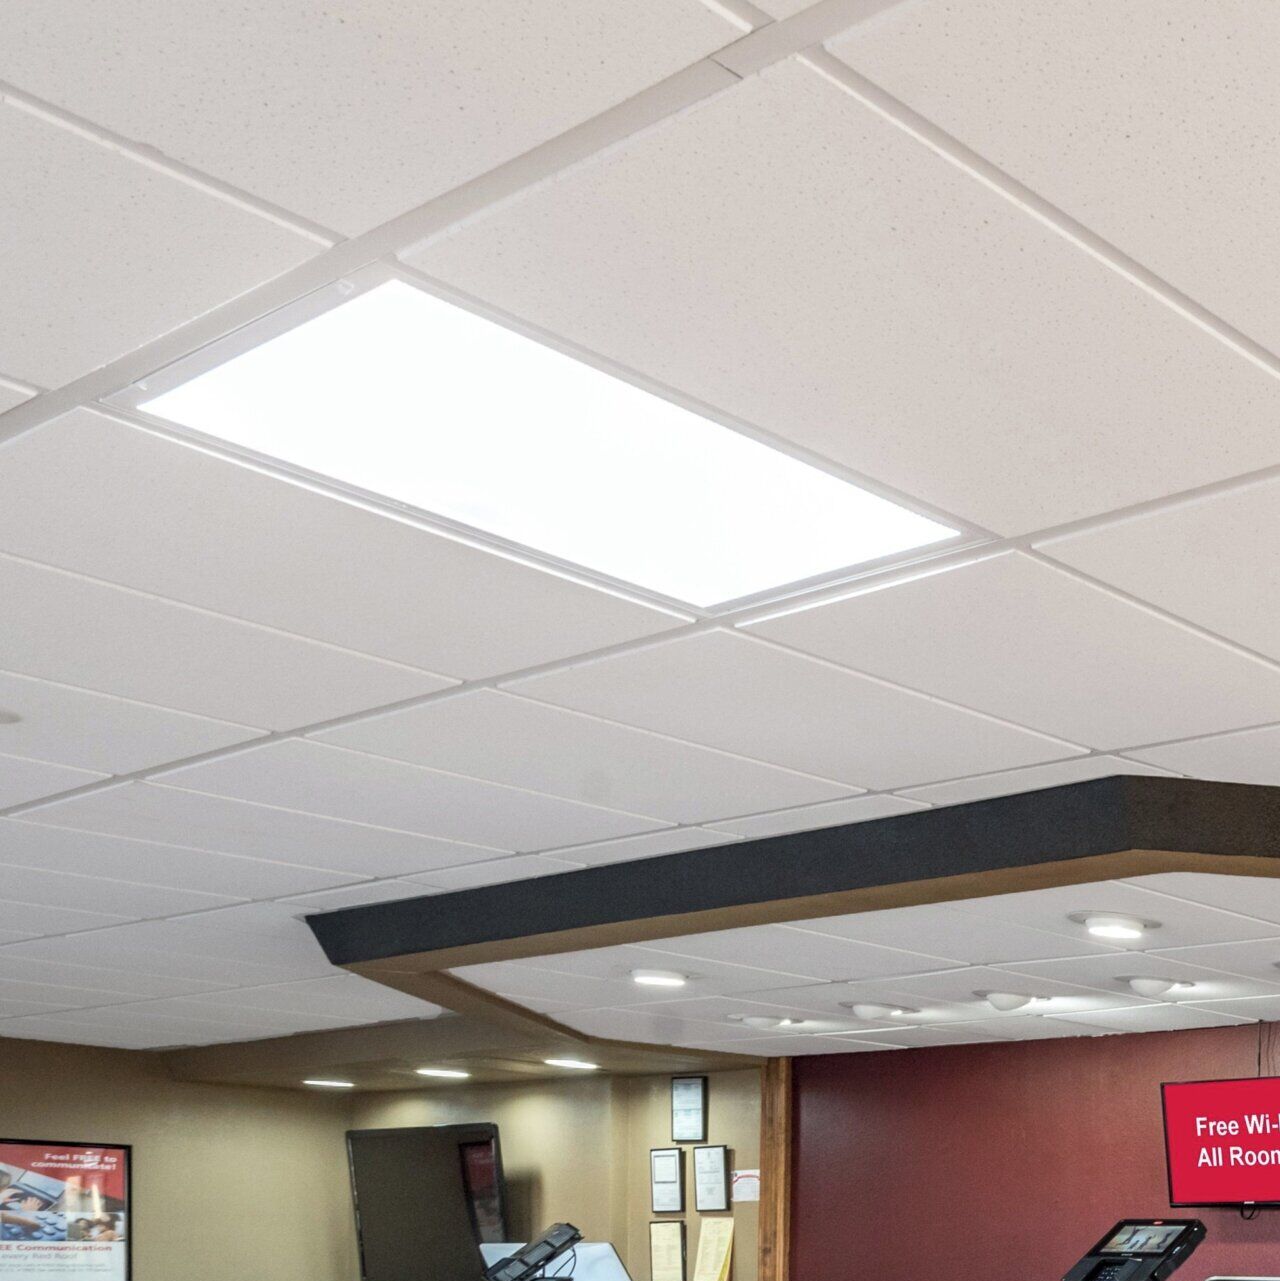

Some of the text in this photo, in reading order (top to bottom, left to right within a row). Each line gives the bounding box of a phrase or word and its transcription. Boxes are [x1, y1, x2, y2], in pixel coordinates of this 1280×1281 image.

[1195, 1116, 1240, 1137] Free
[44, 1152, 70, 1161] Feel
[104, 1155, 118, 1163] to
[1197, 1146, 1224, 1168] All
[16, 1243, 113, 1252] Communication
